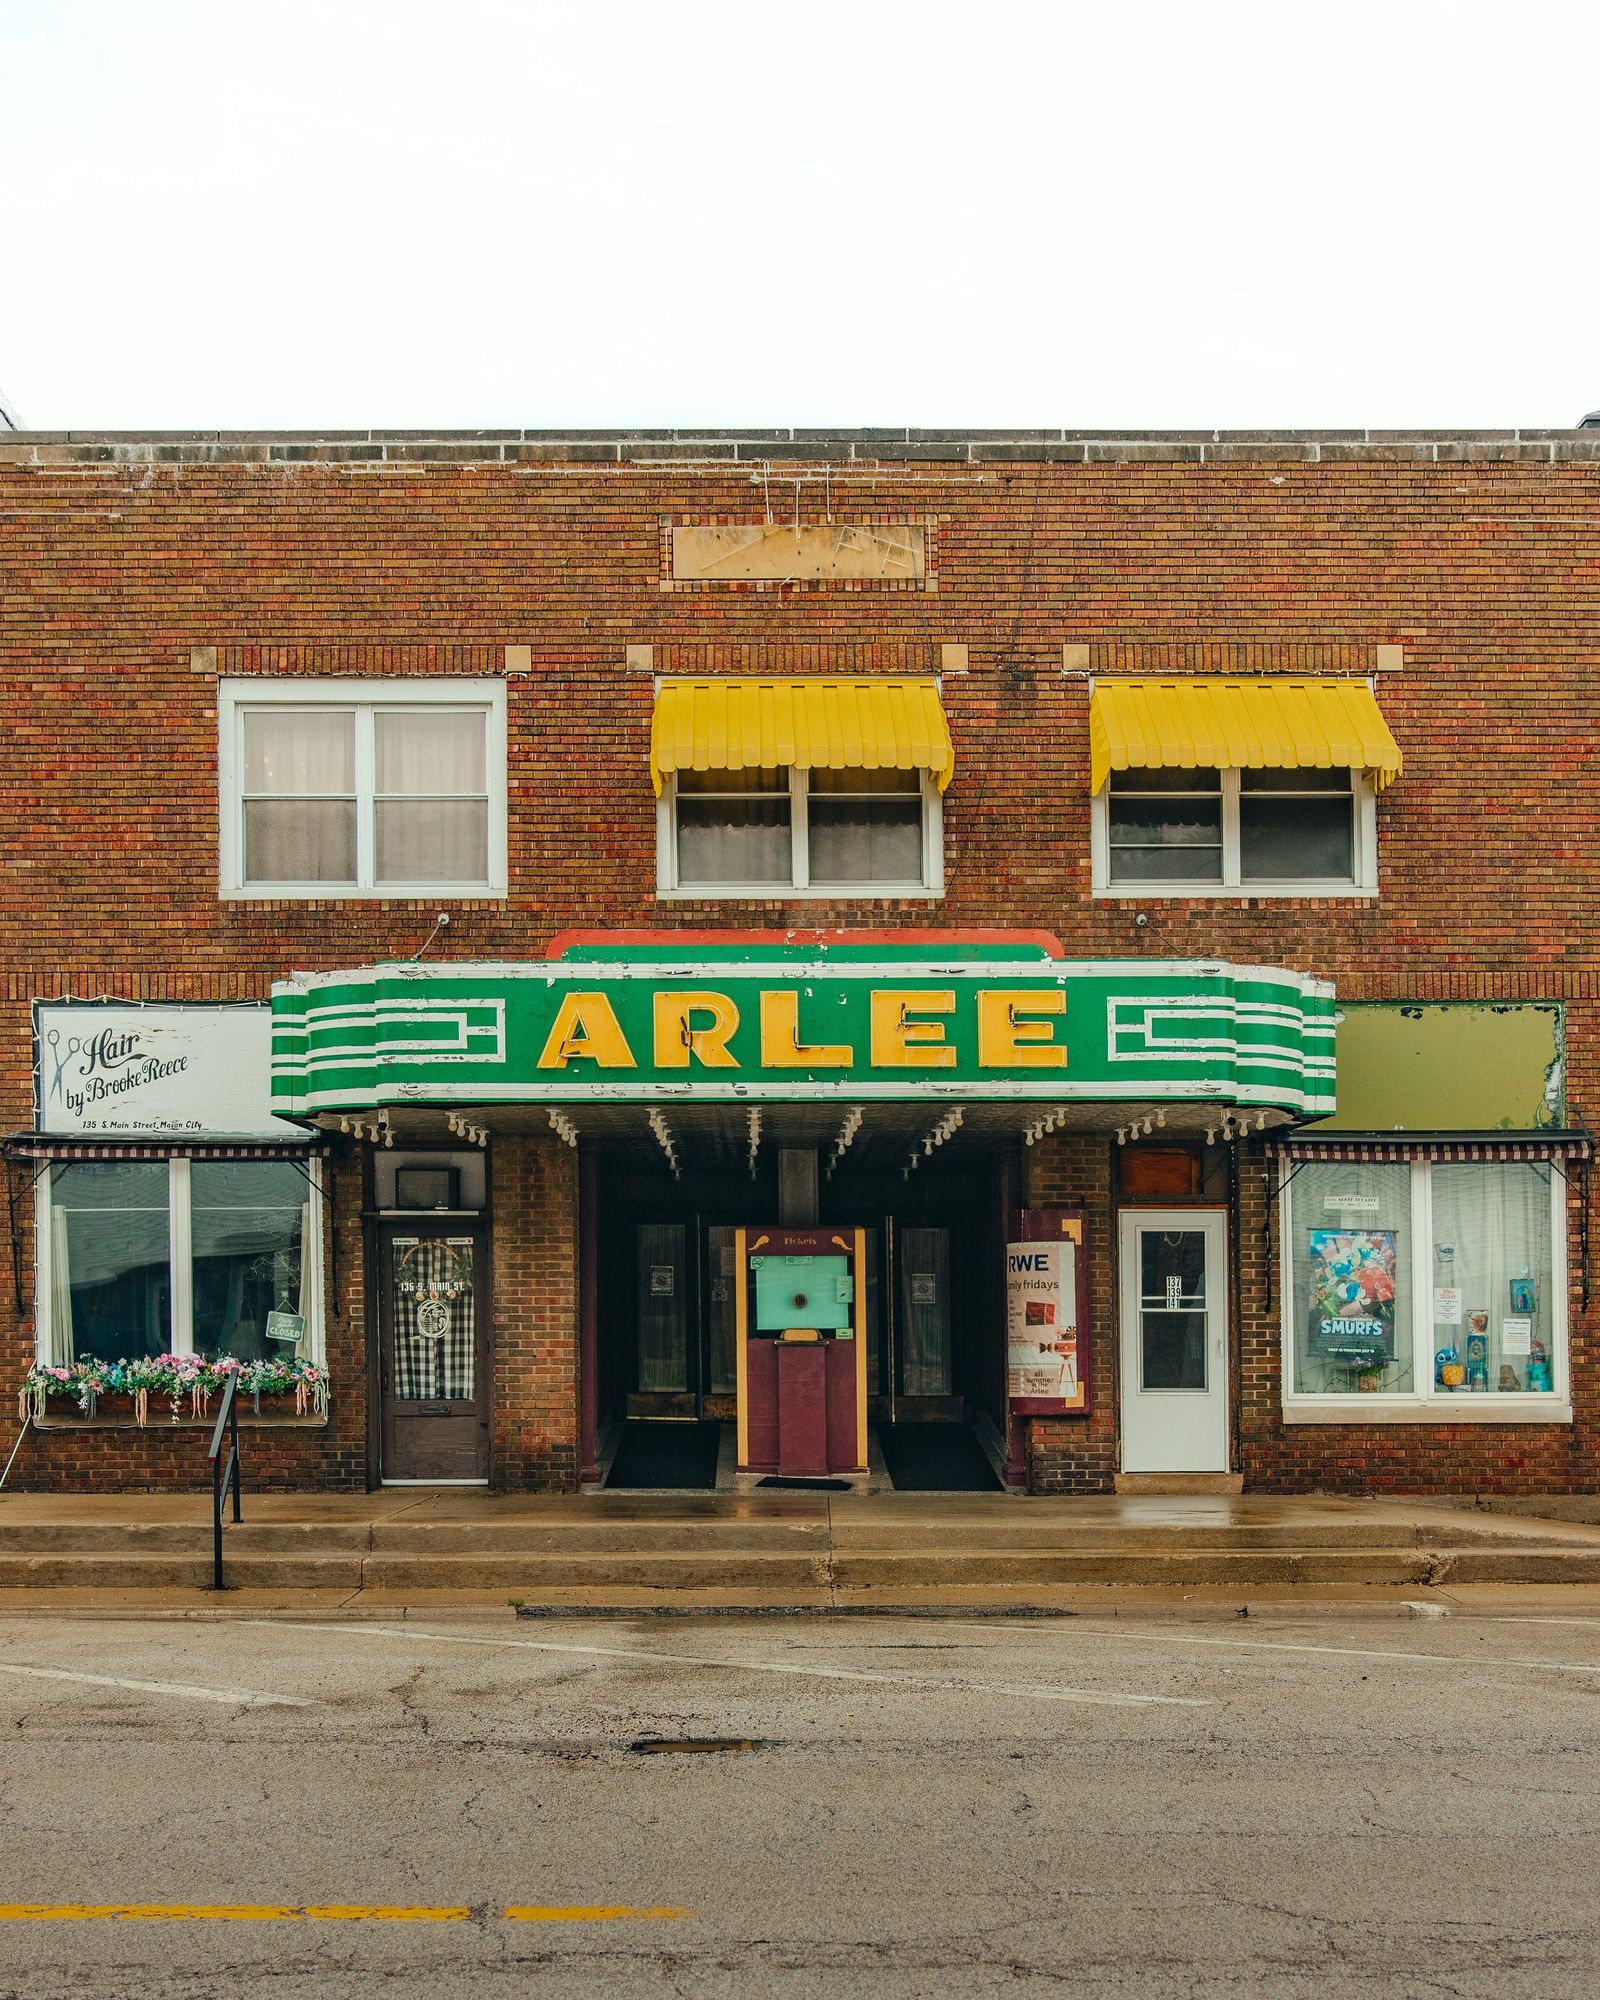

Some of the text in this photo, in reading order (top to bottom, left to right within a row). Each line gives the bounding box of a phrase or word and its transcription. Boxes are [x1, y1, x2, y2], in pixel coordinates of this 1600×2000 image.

[537, 990, 1067, 1068] ARLEE
[79, 1028, 148, 1075] Hair
[66, 1056, 188, 1116] by Brooke Reece
[82, 1120, 97, 1129] 135
[102, 1120, 109, 1129] S.
[110, 1120, 129, 1129] Main
[784, 1237, 817, 1246] Tickets
[401, 1282, 414, 1291] 135
[418, 1282, 426, 1291] S.
[453, 1282, 465, 1291] ST.
[1023, 1279, 1059, 1291] fridays
[1168, 1277, 1181, 1287] 137
[1168, 1288, 1181, 1297] 139
[1168, 1298, 1180, 1308] 141
[269, 1327, 300, 1338] CLOSED
[1321, 1320, 1383, 1336] SMURFS
